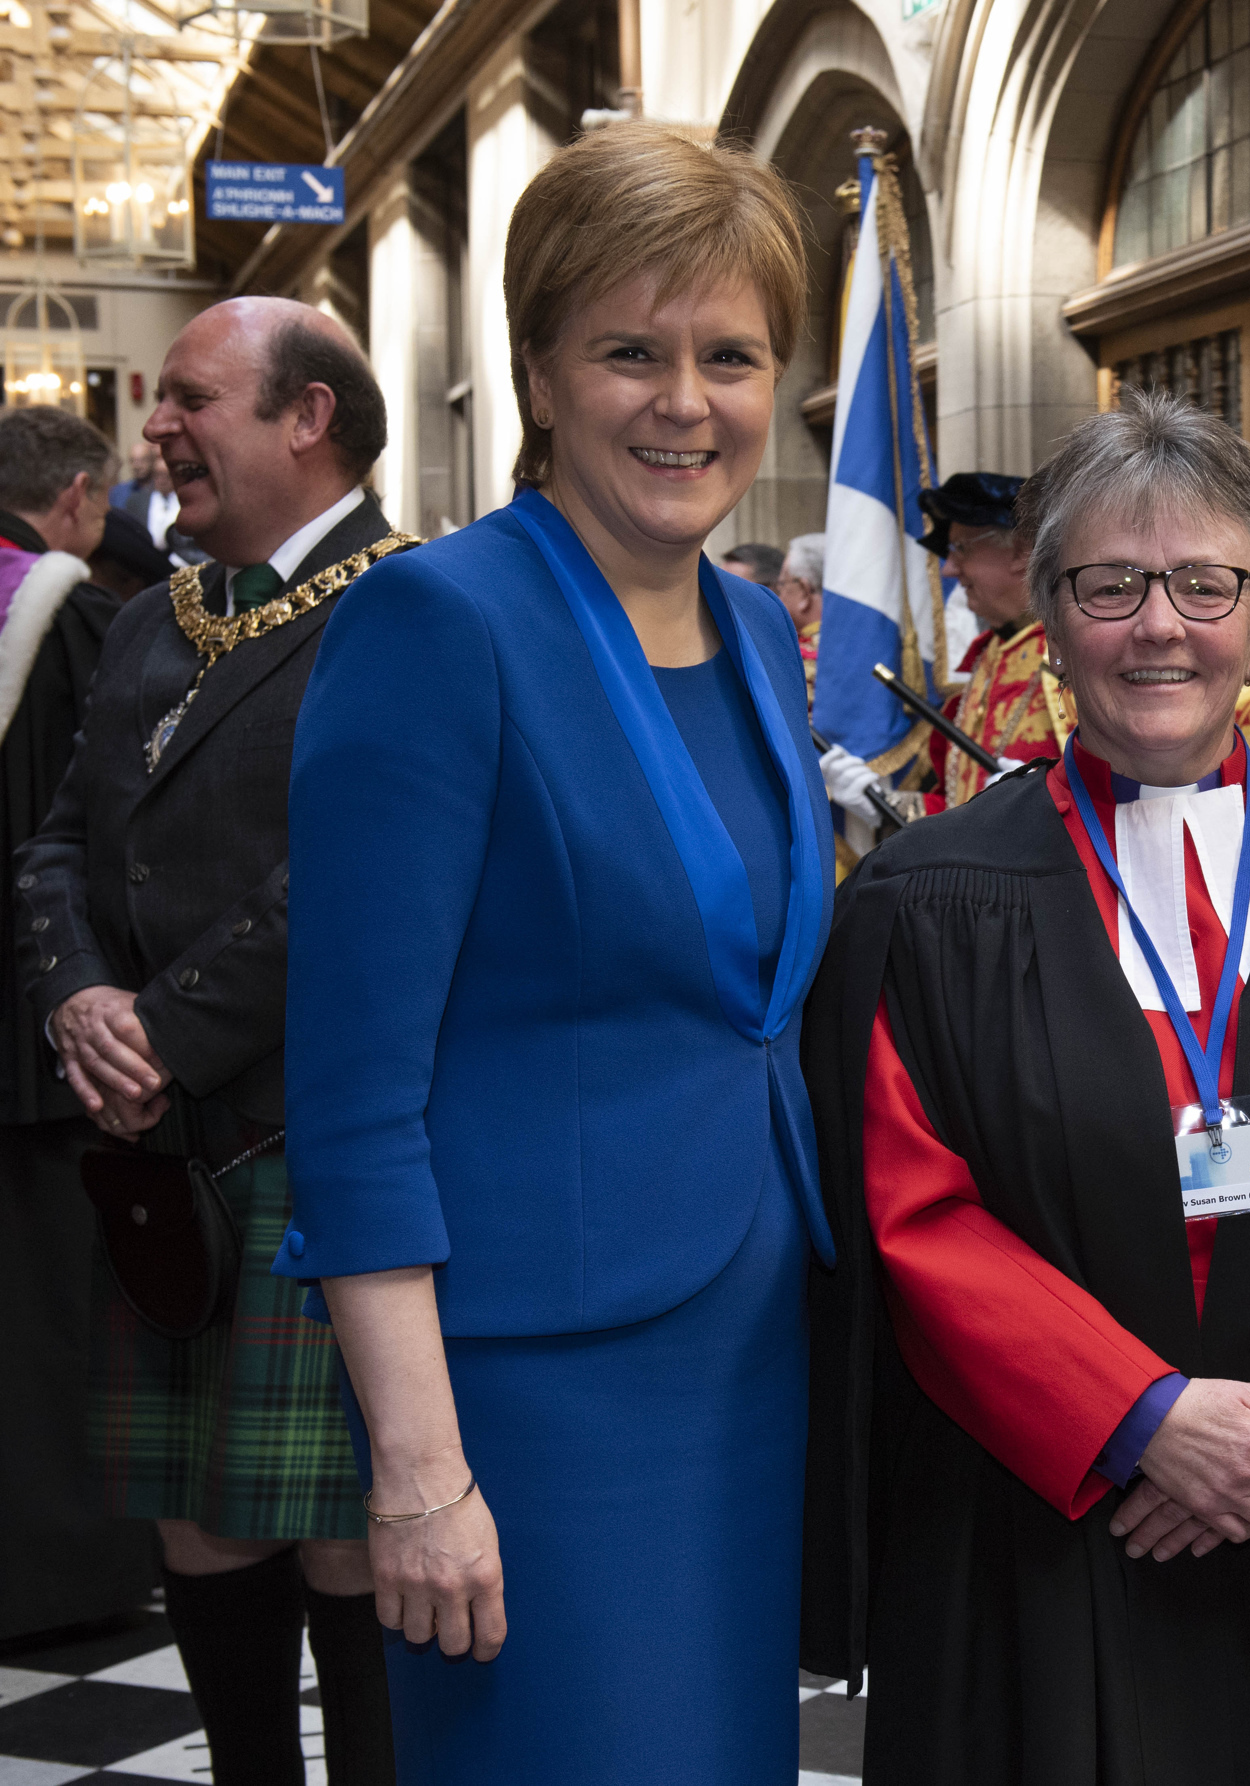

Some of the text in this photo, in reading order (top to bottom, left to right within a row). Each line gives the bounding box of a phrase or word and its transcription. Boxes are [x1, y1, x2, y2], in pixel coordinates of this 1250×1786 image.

[211, 165, 286, 181] MAIN EXIT
[1190, 1196, 1217, 1207] Susan
[1219, 1193, 1247, 1203] Brown
